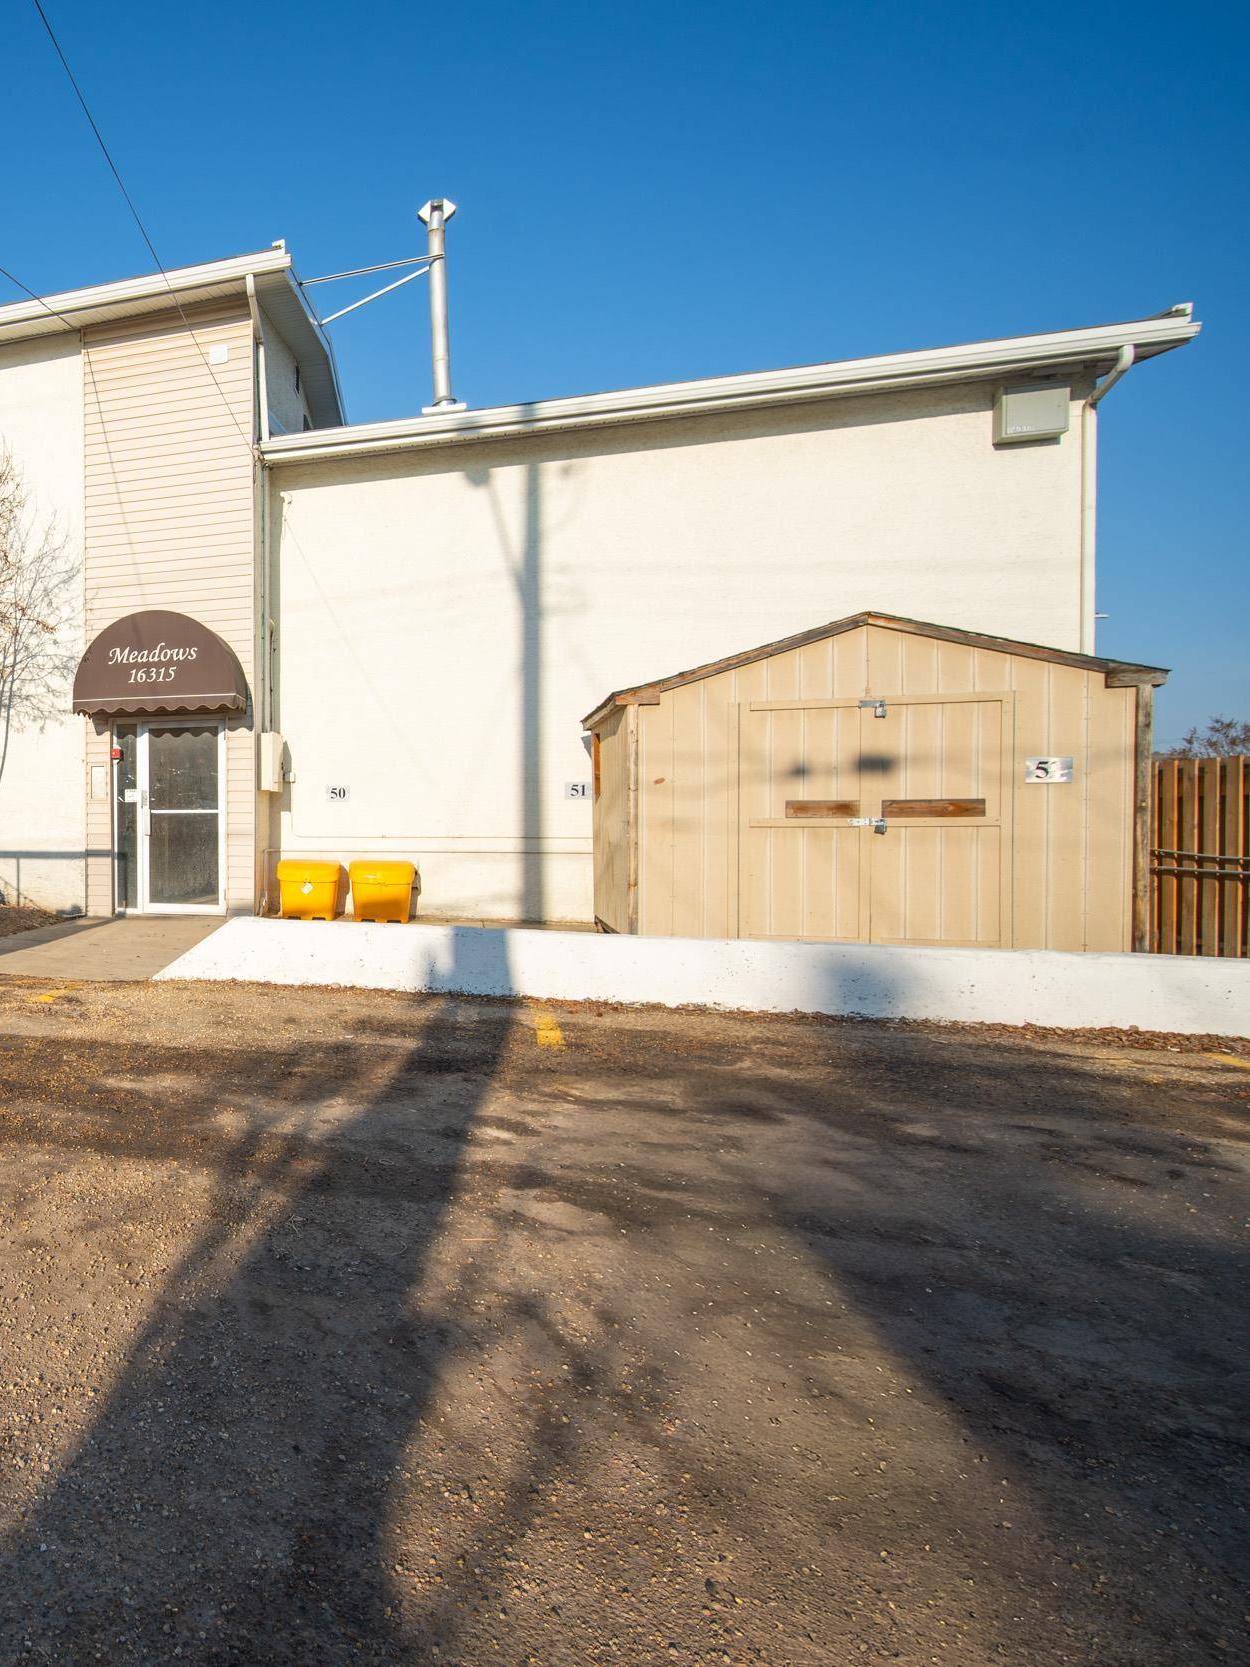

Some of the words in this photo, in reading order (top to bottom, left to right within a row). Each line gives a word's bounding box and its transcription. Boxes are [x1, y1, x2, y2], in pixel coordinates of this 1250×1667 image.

[107, 642, 198, 665] Meadows
[128, 666, 177, 683] 16315
[330, 787, 346, 800] 50
[570, 784, 586, 797] 51
